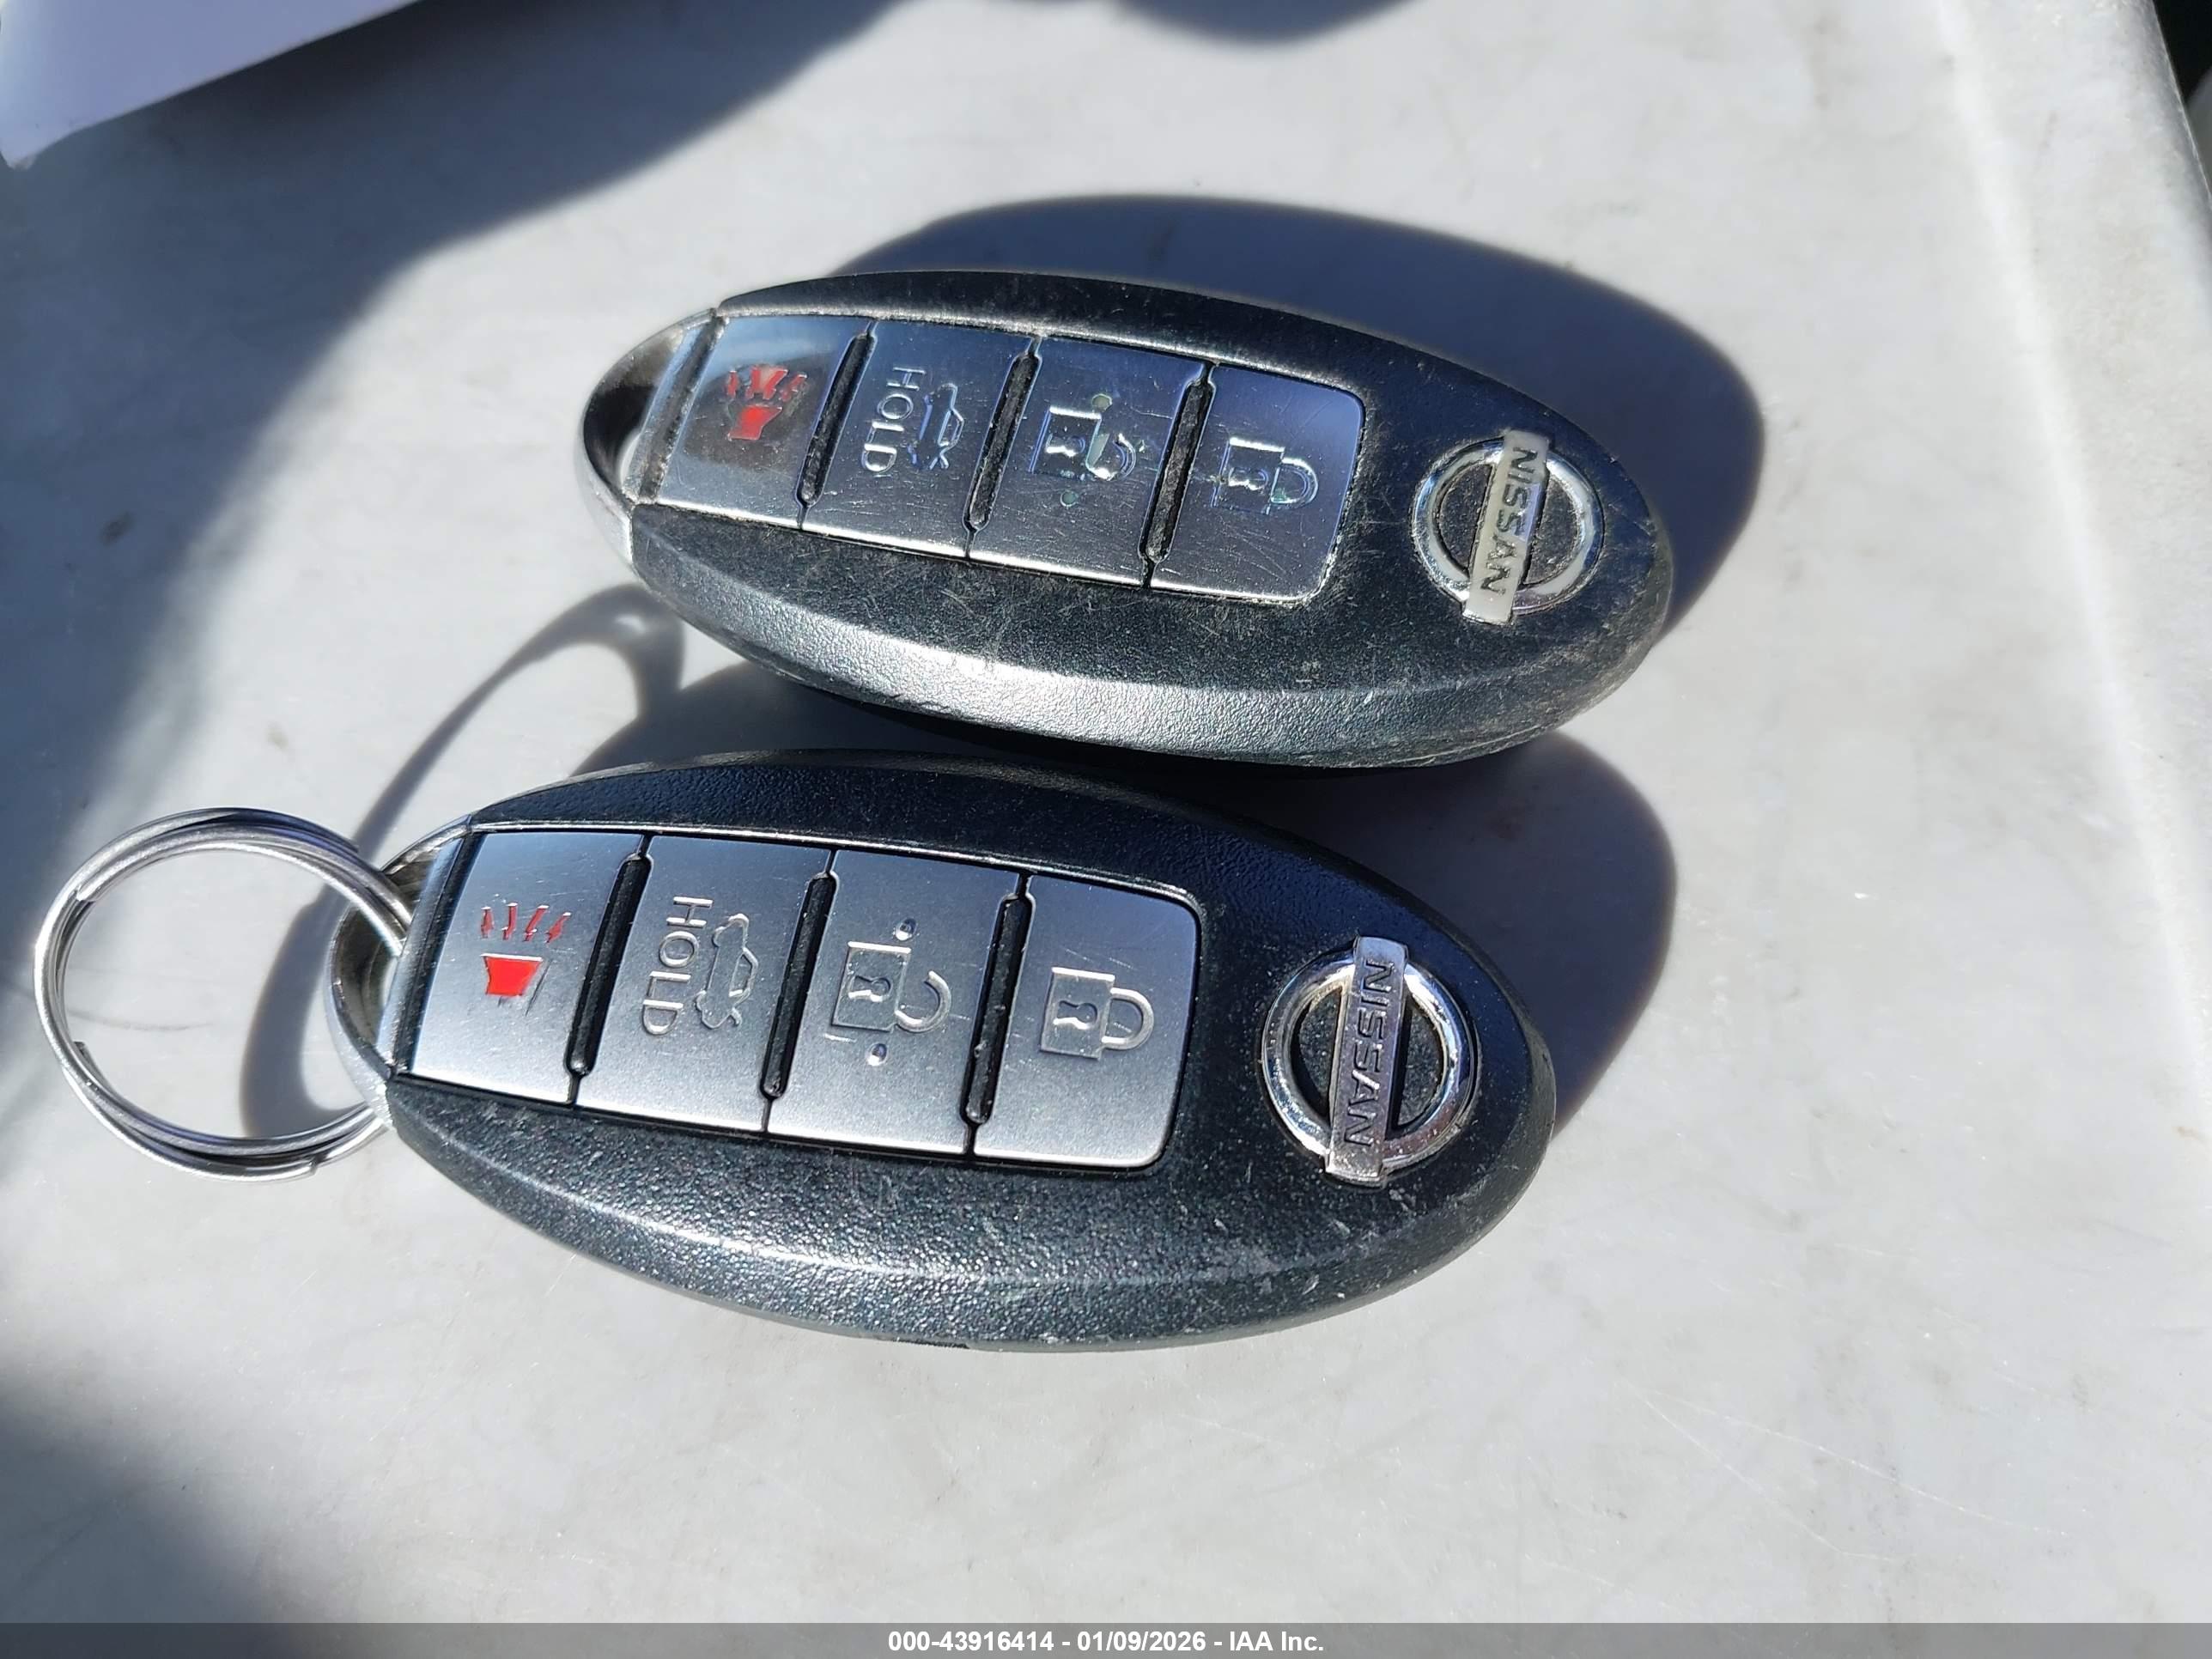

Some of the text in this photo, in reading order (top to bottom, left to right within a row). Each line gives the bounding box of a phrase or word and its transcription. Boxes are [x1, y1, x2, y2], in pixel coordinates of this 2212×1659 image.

[860, 367, 927, 472] HOLD
[1480, 446, 1539, 595] NISSAN
[642, 896, 714, 1036] HOLD
[1344, 958, 1395, 1147] NISSAN
